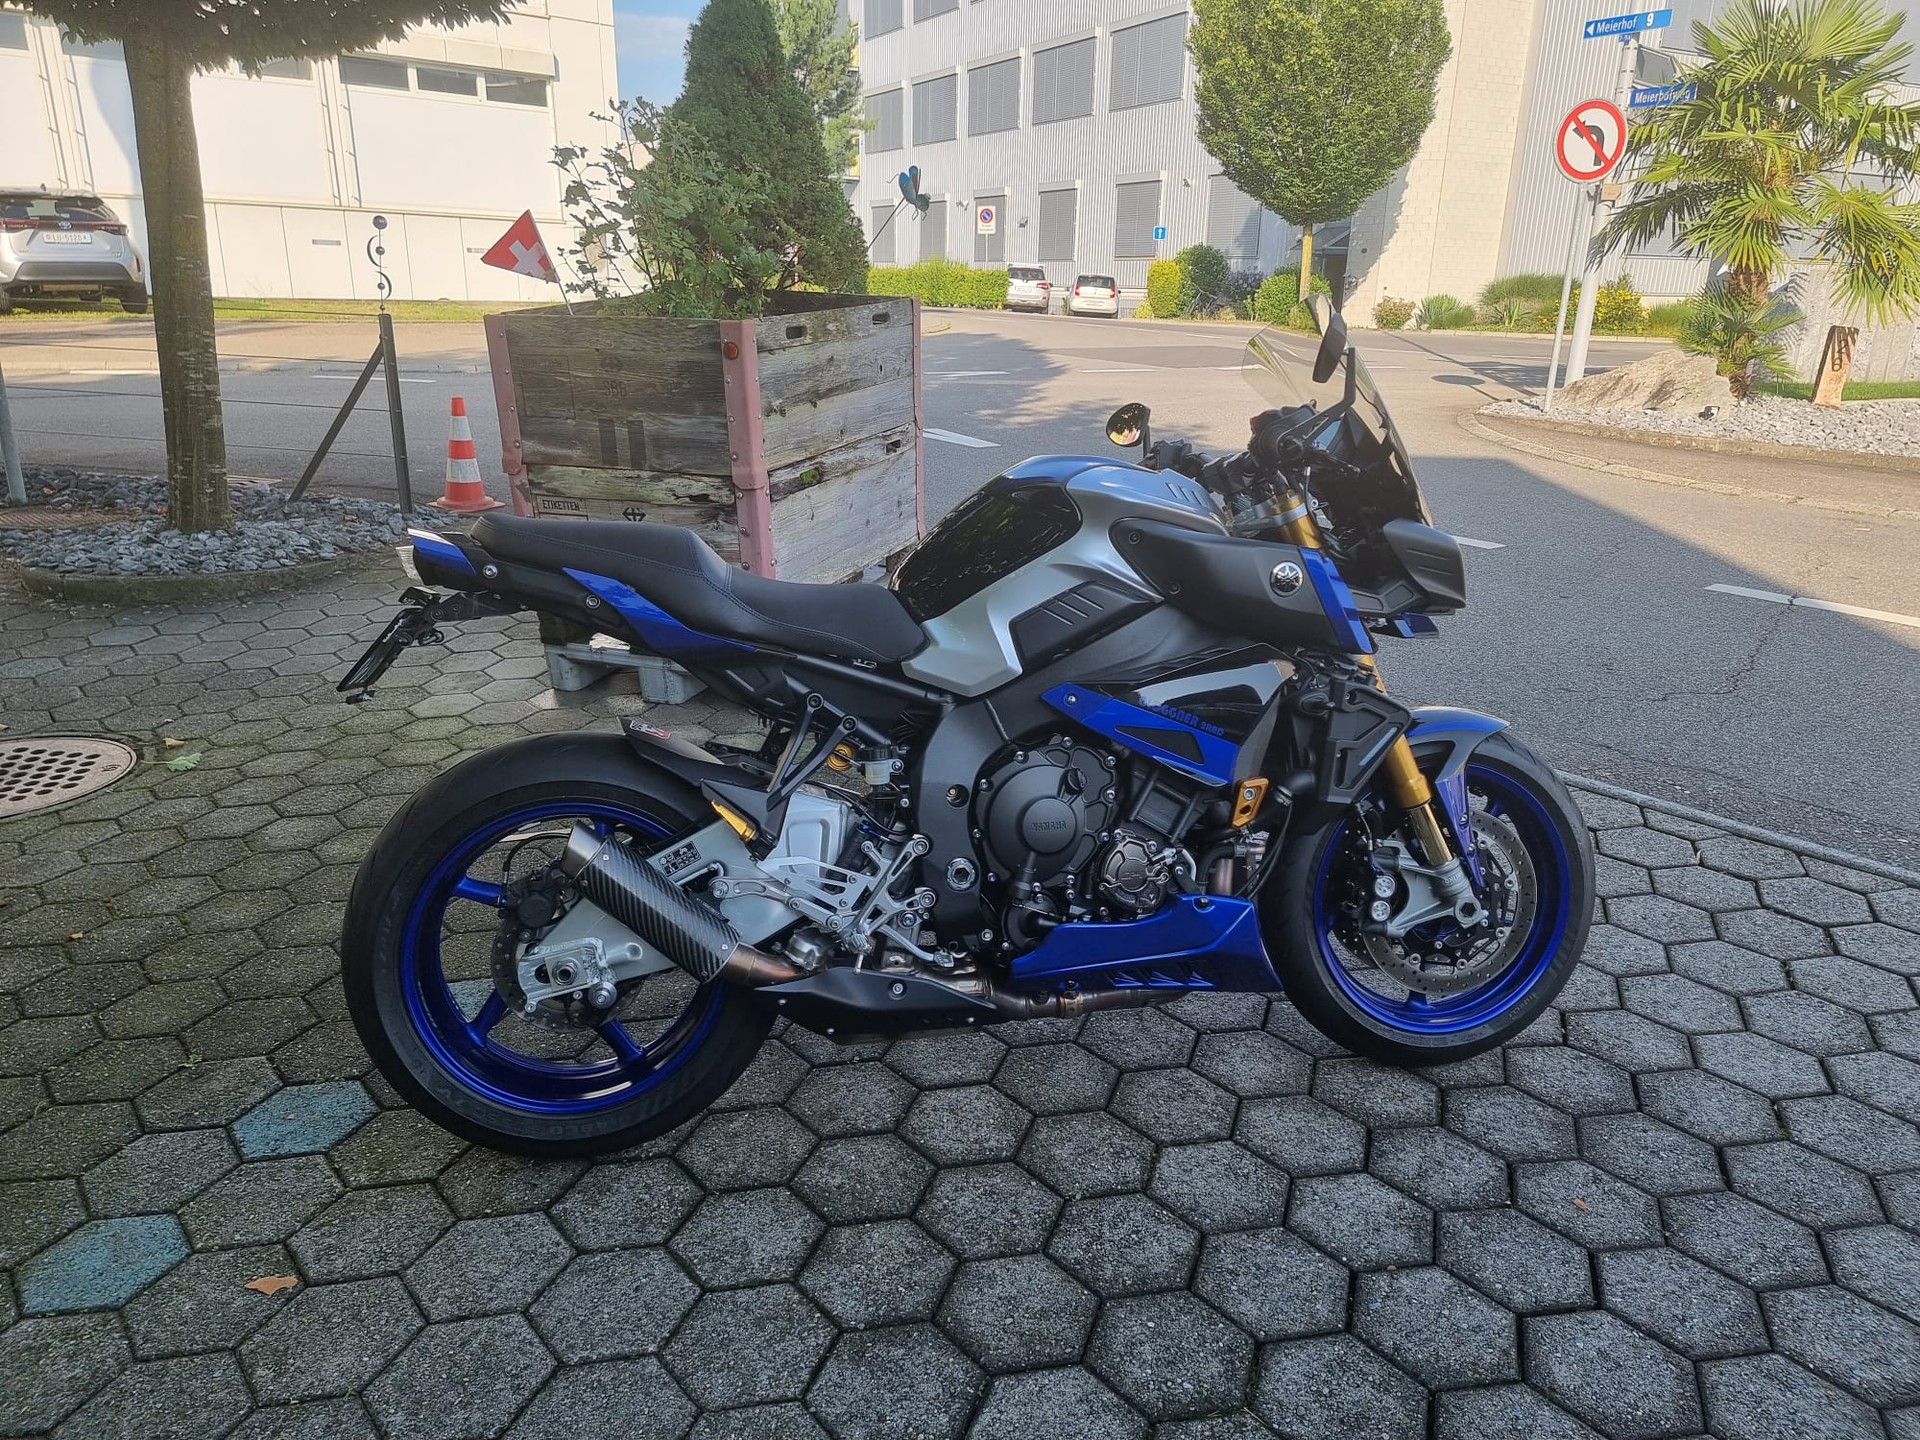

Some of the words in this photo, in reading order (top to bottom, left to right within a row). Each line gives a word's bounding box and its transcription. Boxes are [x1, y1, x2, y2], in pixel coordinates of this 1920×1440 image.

[1596, 16, 1638, 33] Meierhof
[1646, 13, 1654, 27] 9
[542, 499, 580, 512] ETIKETTEN
[1031, 820, 1067, 831] YAMAHA
